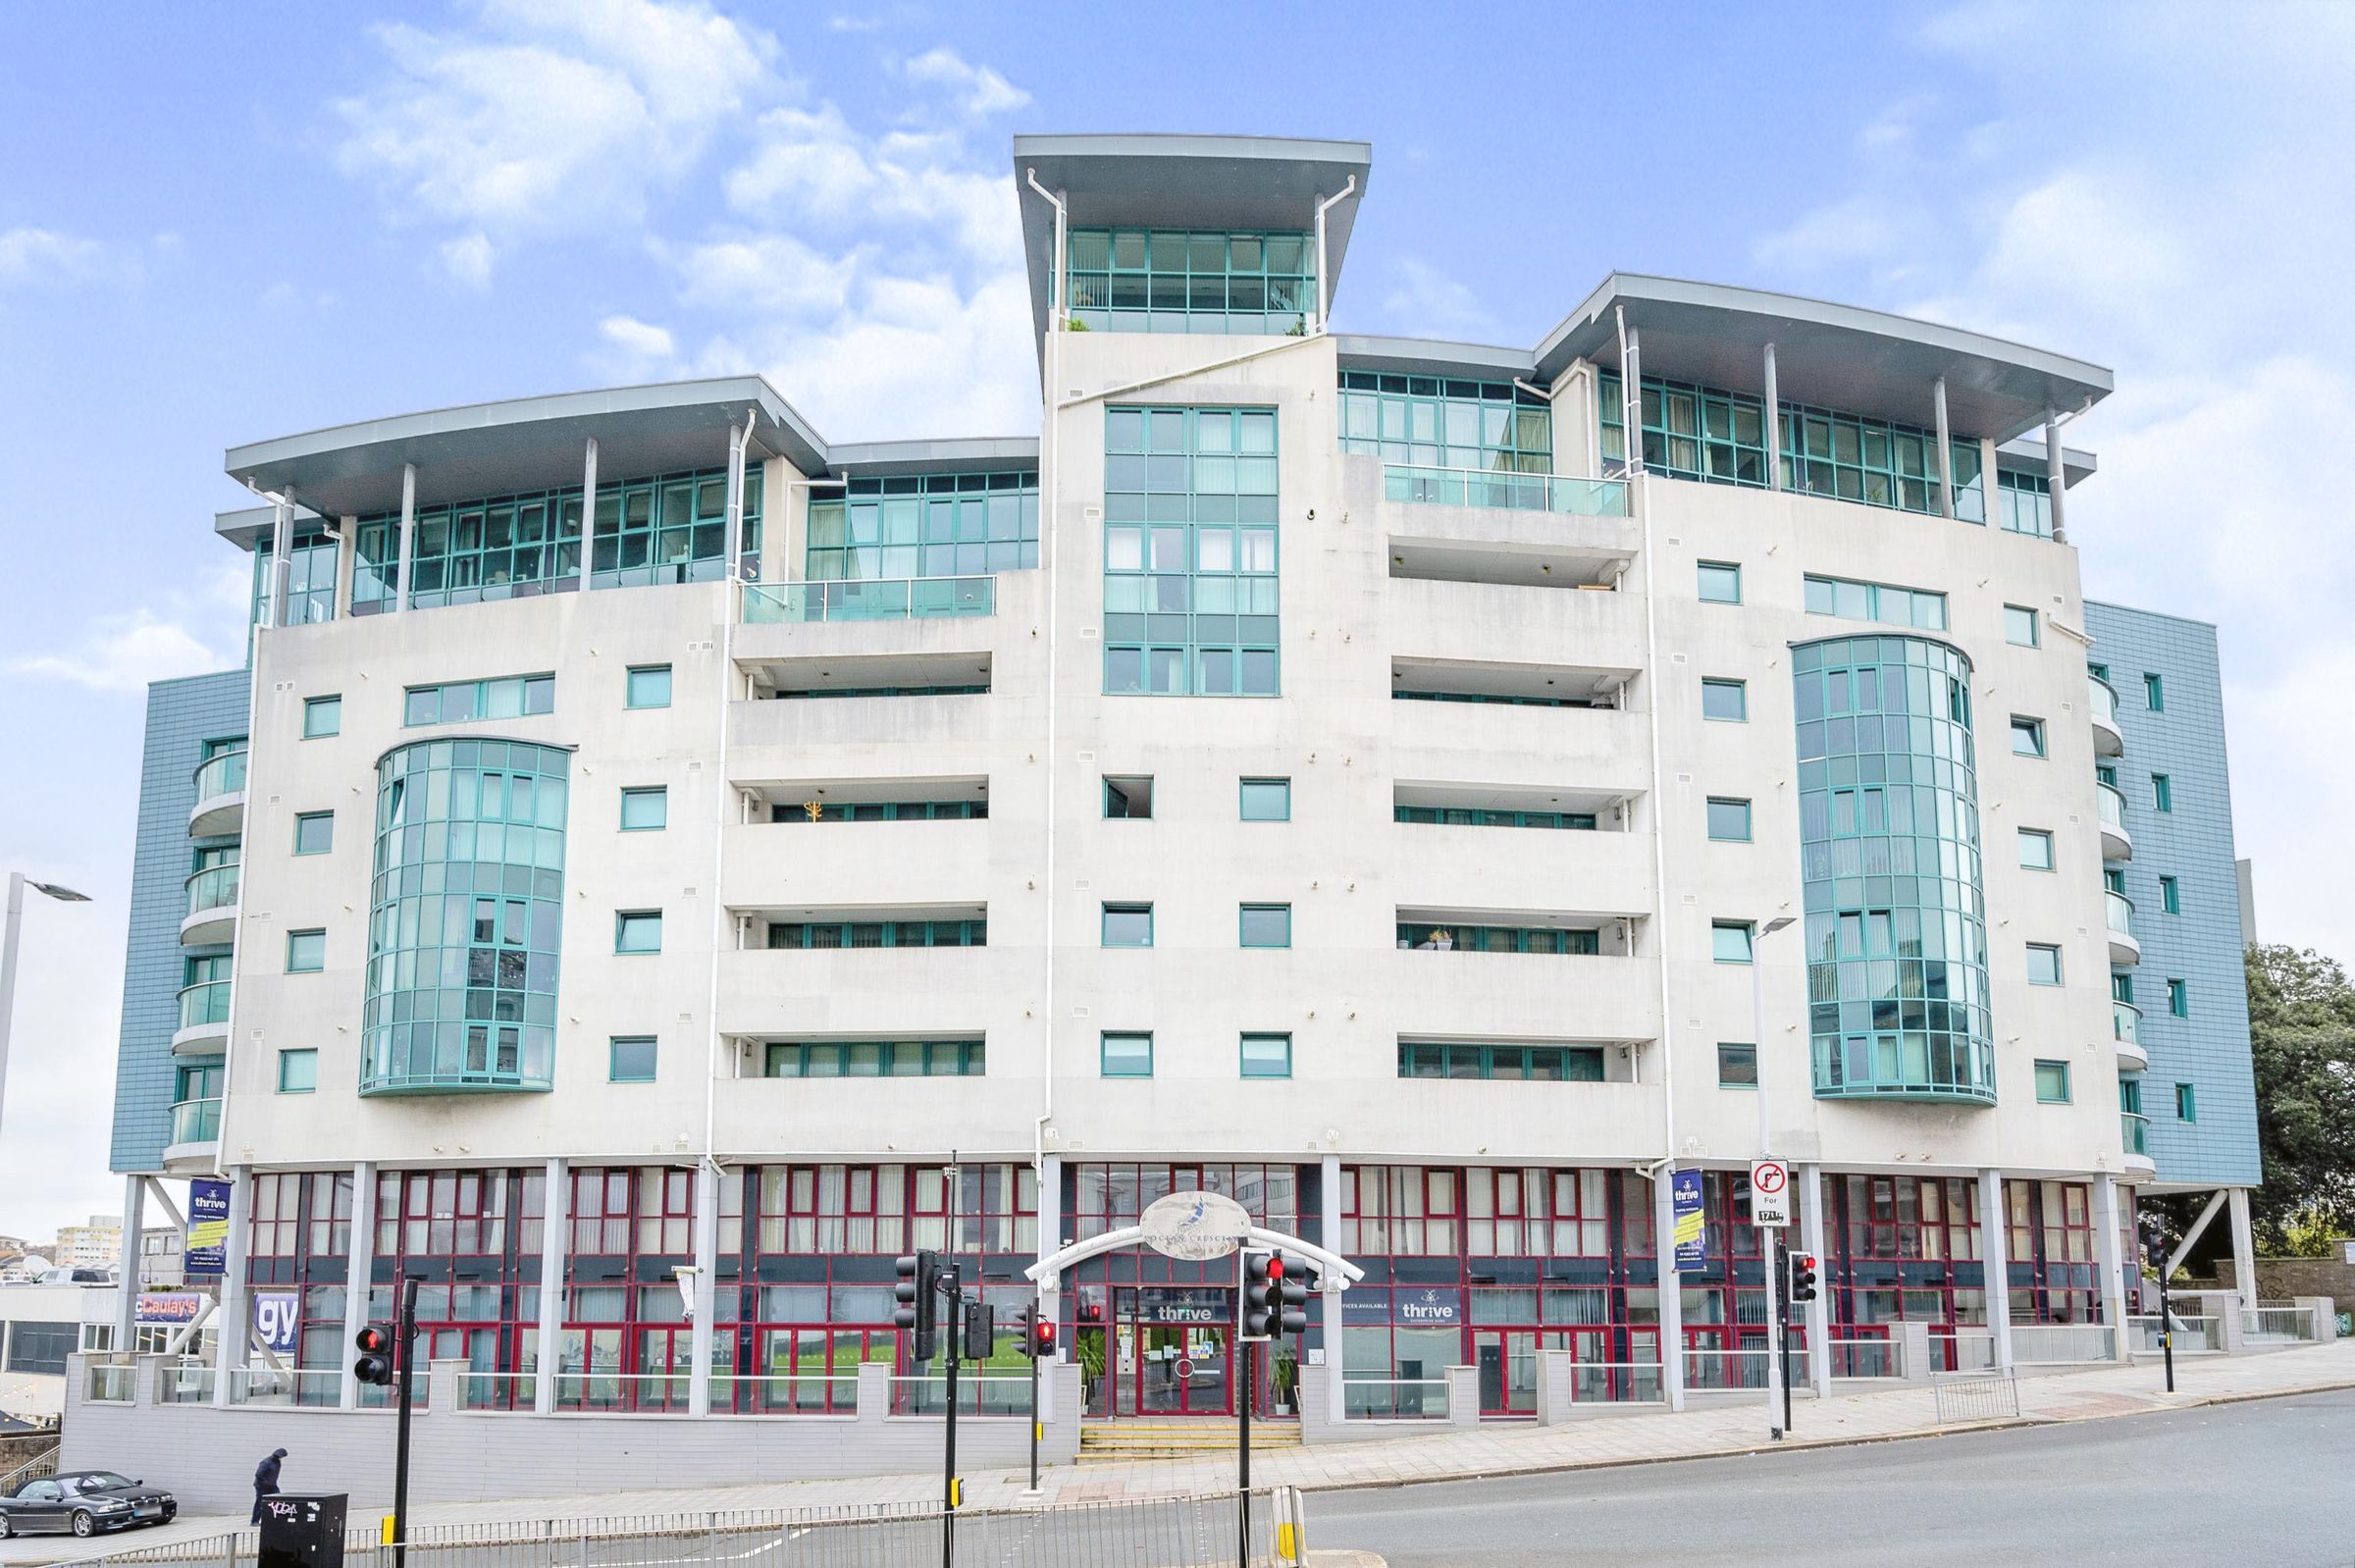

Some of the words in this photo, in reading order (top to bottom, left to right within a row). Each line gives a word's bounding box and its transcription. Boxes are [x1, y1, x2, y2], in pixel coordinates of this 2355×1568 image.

[195, 1197, 226, 1209] thrive
[1675, 1190, 1699, 1201] thrive
[135, 1297, 196, 1317] cCaulay's
[1158, 1306, 1212, 1321] thrive
[1402, 1303, 1453, 1318] thrive
[258, 1300, 298, 1345] gy
